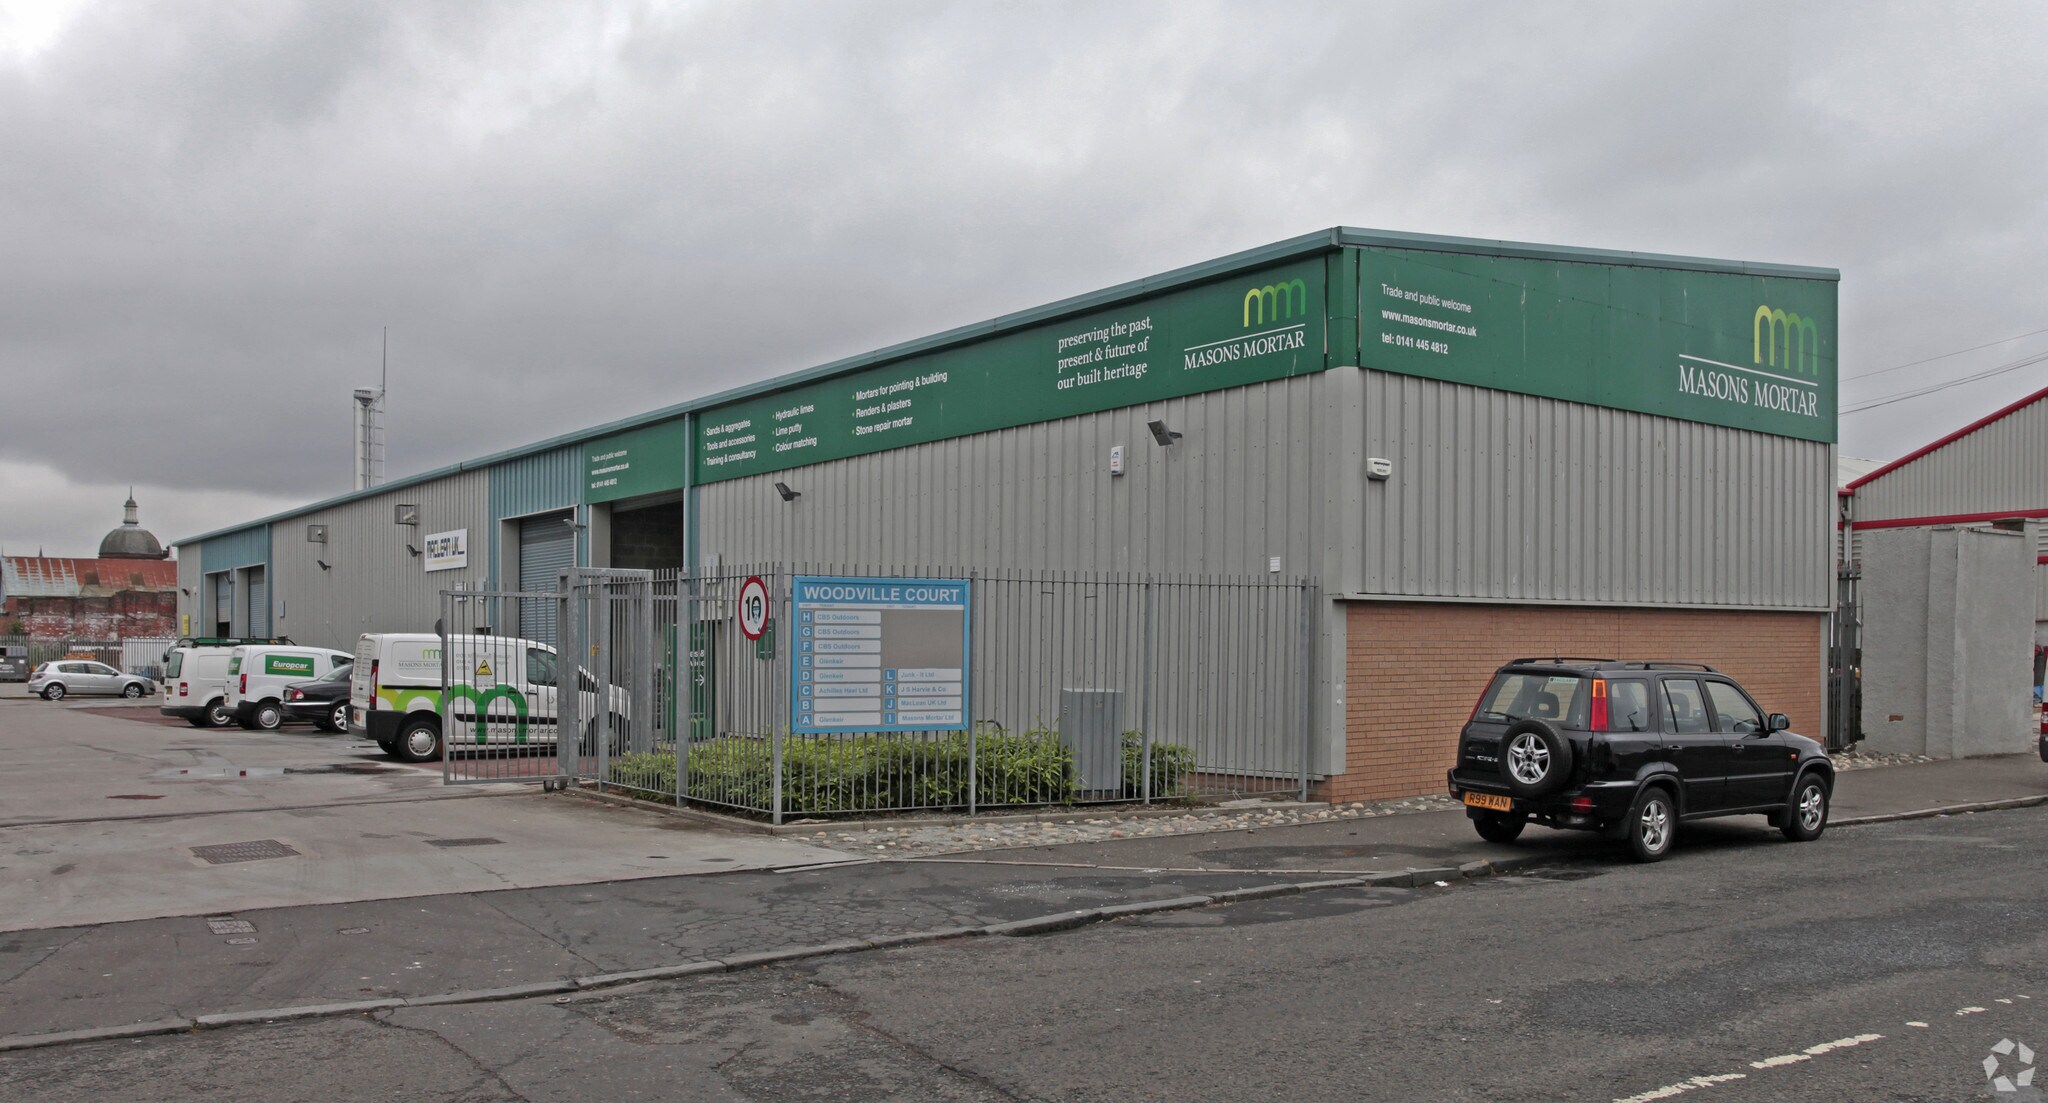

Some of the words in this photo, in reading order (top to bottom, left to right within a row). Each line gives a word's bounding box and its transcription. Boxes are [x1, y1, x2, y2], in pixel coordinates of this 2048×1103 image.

[1382, 284, 1402, 298] Trade
[1404, 291, 1418, 302] and
[1420, 294, 1440, 306] public
[1442, 300, 1472, 313] welcome
[1382, 310, 1477, 336] www.masonsmortar.co.uk
[1058, 327, 1109, 353] preserving
[1111, 322, 1126, 336] the
[1129, 316, 1152, 337] past,
[1184, 344, 1240, 370] MASONS
[1243, 330, 1305, 358] MORTAR
[1382, 332, 1394, 344] tel:
[1396, 335, 1414, 348] 0141
[1416, 339, 1429, 350] 445
[1430, 342, 1448, 354] 4812
[1058, 350, 1092, 374] present
[1094, 348, 1102, 361] &
[1105, 345, 1136, 359] future
[1138, 336, 1150, 352] of
[1058, 378, 1075, 390] our
[1078, 368, 1101, 386] built
[1104, 362, 1147, 380] heritage
[856, 390, 878, 400] Mortars
[880, 386, 888, 395] for
[889, 380, 914, 395] pointing
[915, 376, 920, 386] &
[922, 372, 948, 386] building
[1679, 365, 1748, 404] MASONS
[1754, 381, 1818, 417] MORTAR
[776, 406, 799, 421] Hydraulic
[800, 404, 814, 414] limes
[856, 406, 880, 418] Renders
[881, 403, 886, 412] &
[887, 399, 911, 413] plasters
[706, 426, 720, 436] Sands
[720, 424, 724, 433] &
[725, 420, 750, 433] aggregates
[776, 427, 788, 436] Lime
[788, 424, 802, 436] putty
[856, 426, 872, 436] Stone
[874, 420, 892, 432] repair
[892, 416, 913, 428] mortar
[706, 442, 718, 451] Tools
[719, 439, 728, 448] and
[728, 434, 756, 447] accessories
[776, 442, 792, 452] Colour
[793, 437, 817, 448] matching
[706, 456, 724, 466] Training
[724, 454, 728, 462] &
[728, 450, 756, 462] consultancy
[804, 586, 900, 600] WOODVILLE
[905, 588, 960, 602] COURT
[746, 596, 762, 622] 10
[802, 612, 810, 621] H
[802, 627, 811, 636] G
[803, 642, 810, 650] F
[272, 660, 308, 670] Europcar
[802, 656, 810, 666] E
[802, 671, 810, 680] D
[887, 671, 893, 679] L
[802, 686, 810, 695] C
[886, 685, 893, 694] K
[802, 701, 810, 709] B
[888, 700, 893, 708] J
[802, 716, 810, 724] A
[1469, 793, 1487, 805] R99
